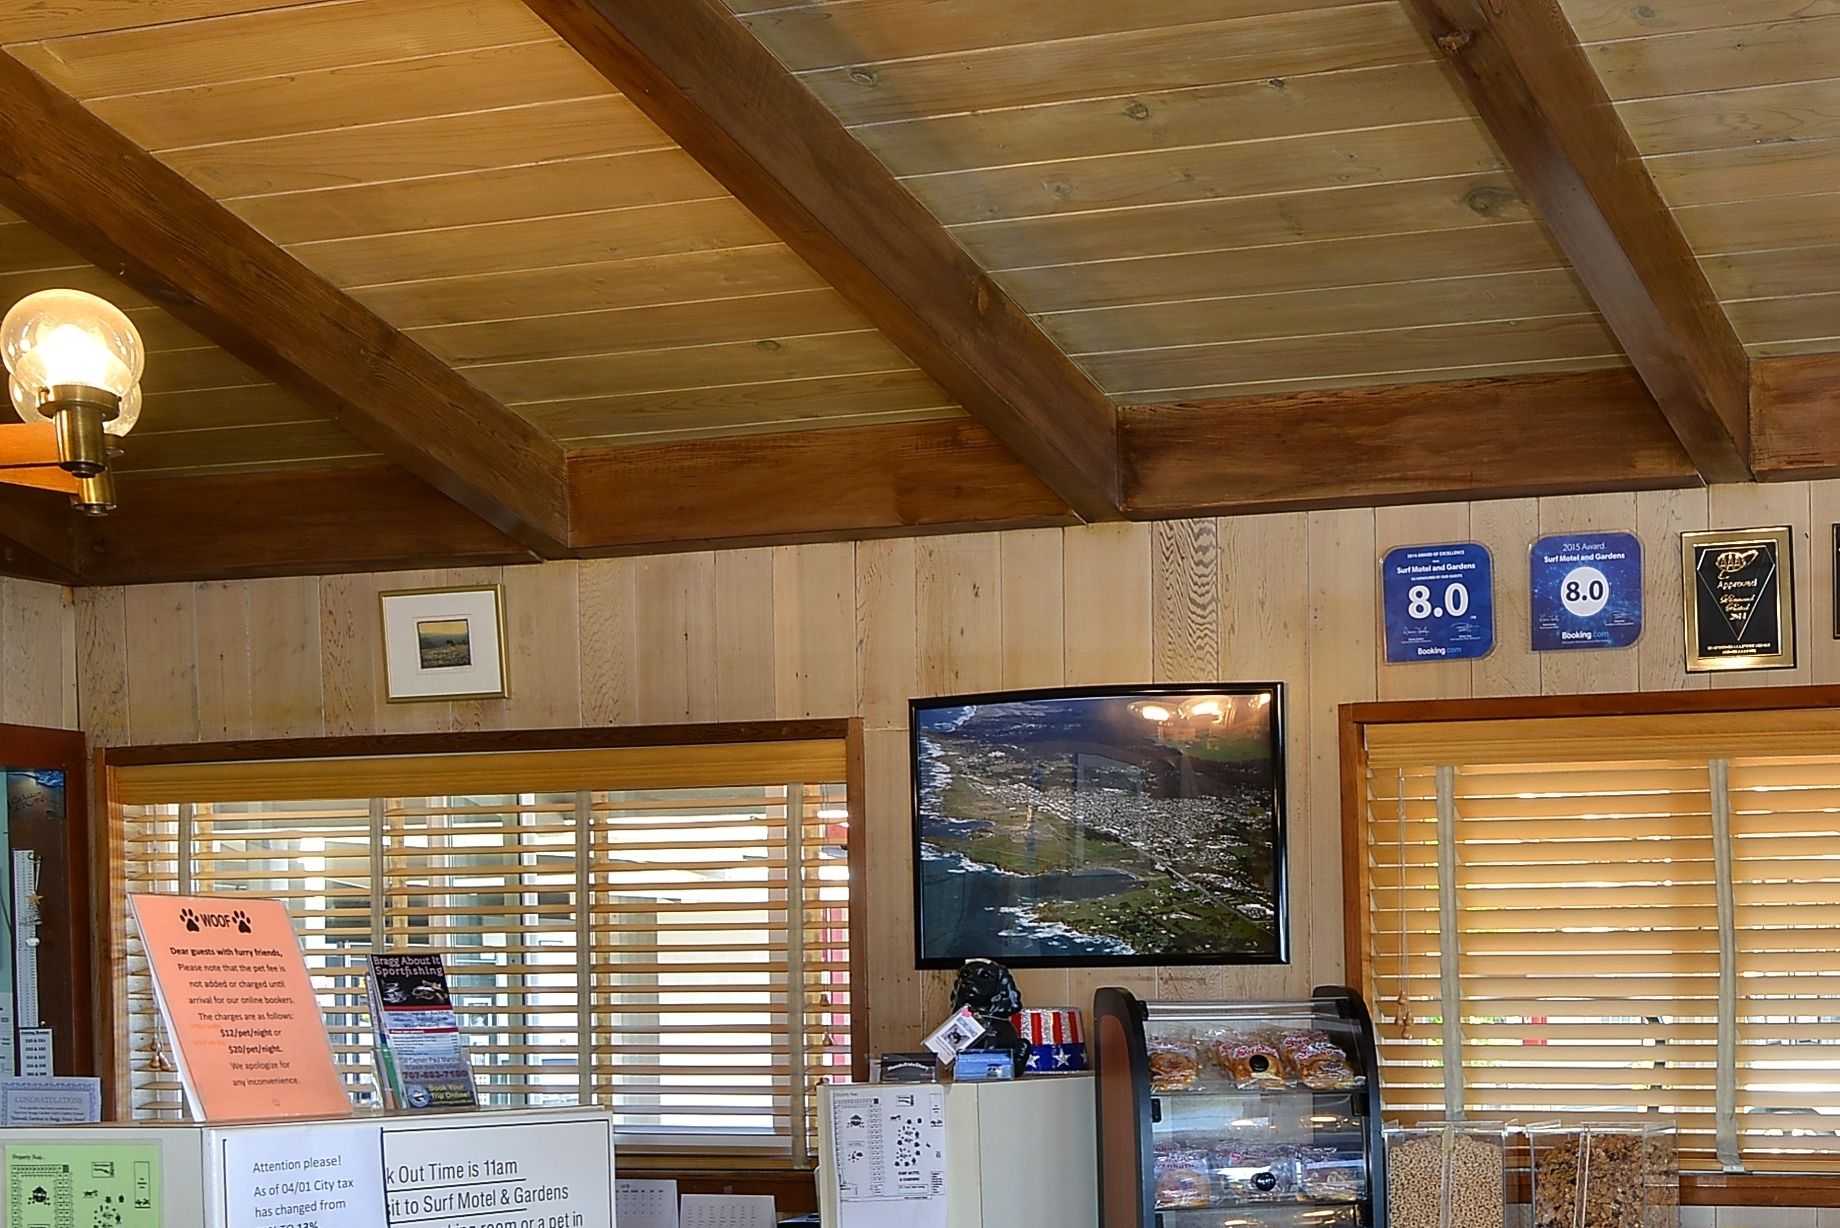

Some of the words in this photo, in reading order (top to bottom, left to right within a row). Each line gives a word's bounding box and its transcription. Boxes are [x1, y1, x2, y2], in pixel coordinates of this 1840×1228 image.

[1562, 543, 1581, 551] 2015
[1582, 542, 1605, 550] Award
[1544, 555, 1559, 564] Surf
[1560, 554, 1579, 563] Motel
[1580, 554, 1593, 562] and
[1594, 552, 1625, 562] Gardens
[1397, 566, 1411, 574] Surf
[1411, 565, 1431, 573] Motel
[1565, 580, 1604, 602] 8.0
[1408, 582, 1468, 619] 8.0
[200, 913, 230, 928] WOOF
[170, 947, 189, 955] Dear
[191, 948, 215, 957] guests
[216, 948, 234, 956] with
[235, 949, 253, 957] furry
[254, 948, 283, 958] friends,
[373, 956, 399, 967] Bragg
[401, 956, 429, 965] About
[431, 956, 440, 965] It
[375, 966, 444, 977] Sportfishing
[253, 1159, 301, 1174] Attention
[303, 1155, 342, 1171] please!
[399, 1165, 425, 1184] Out
[428, 1161, 464, 1180] Time
[468, 1161, 479, 1178] is
[484, 1159, 518, 1176] 11am
[254, 1185, 266, 1197] As
[269, 1183, 279, 1196] of
[281, 1180, 312, 1195] 04/01
[314, 1179, 335, 1192] City
[337, 1178, 354, 1189] tax
[405, 1199, 419, 1215] to
[423, 1193, 454, 1213] Surf
[457, 1189, 497, 1210] Motel
[500, 1189, 511, 1205] &
[514, 1184, 569, 1204] Gardens
[255, 1205, 273, 1218] has
[275, 1201, 317, 1217] changed
[320, 1199, 346, 1211] from
[572, 1212, 584, 1227] in
